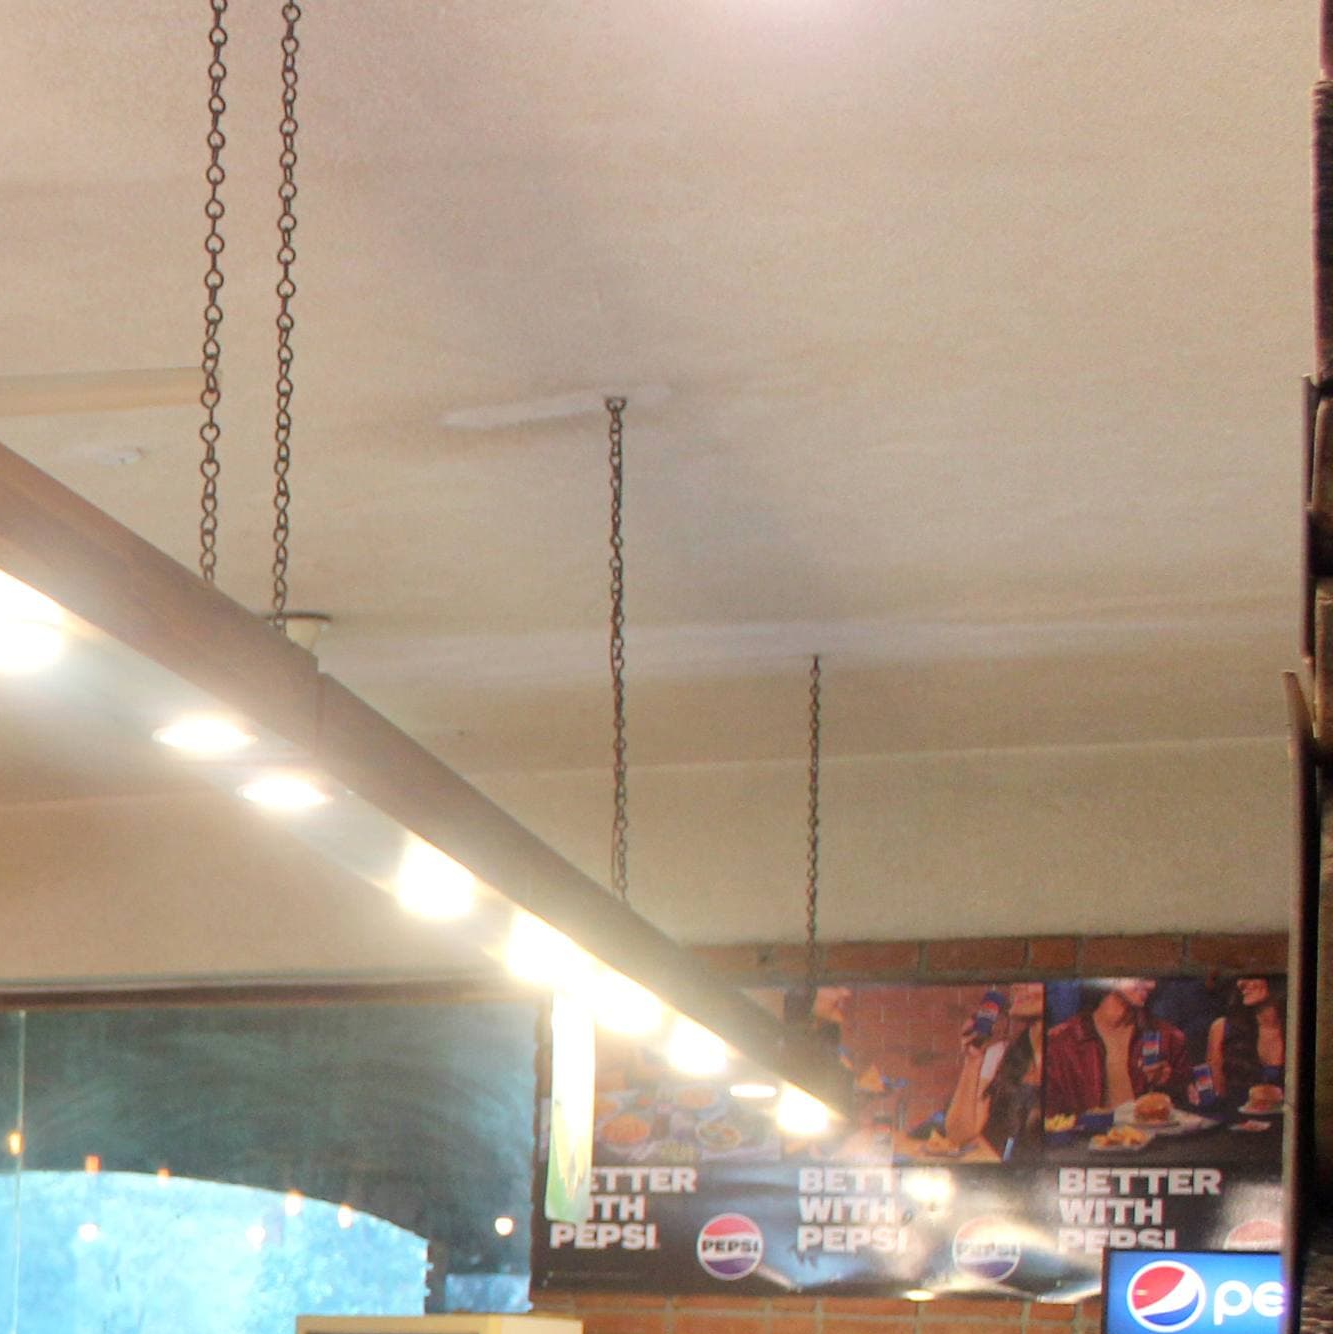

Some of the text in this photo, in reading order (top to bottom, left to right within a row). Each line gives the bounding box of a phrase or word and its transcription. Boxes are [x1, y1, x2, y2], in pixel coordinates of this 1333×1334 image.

[1058, 1167, 1222, 1194] BETTER
[800, 1196, 896, 1223] WITH
[1059, 1197, 1162, 1225] WITH
[549, 1222, 658, 1250] PEPSI
[701, 1238, 761, 1253] PEPSI
[797, 1225, 909, 1254] PEPSI
